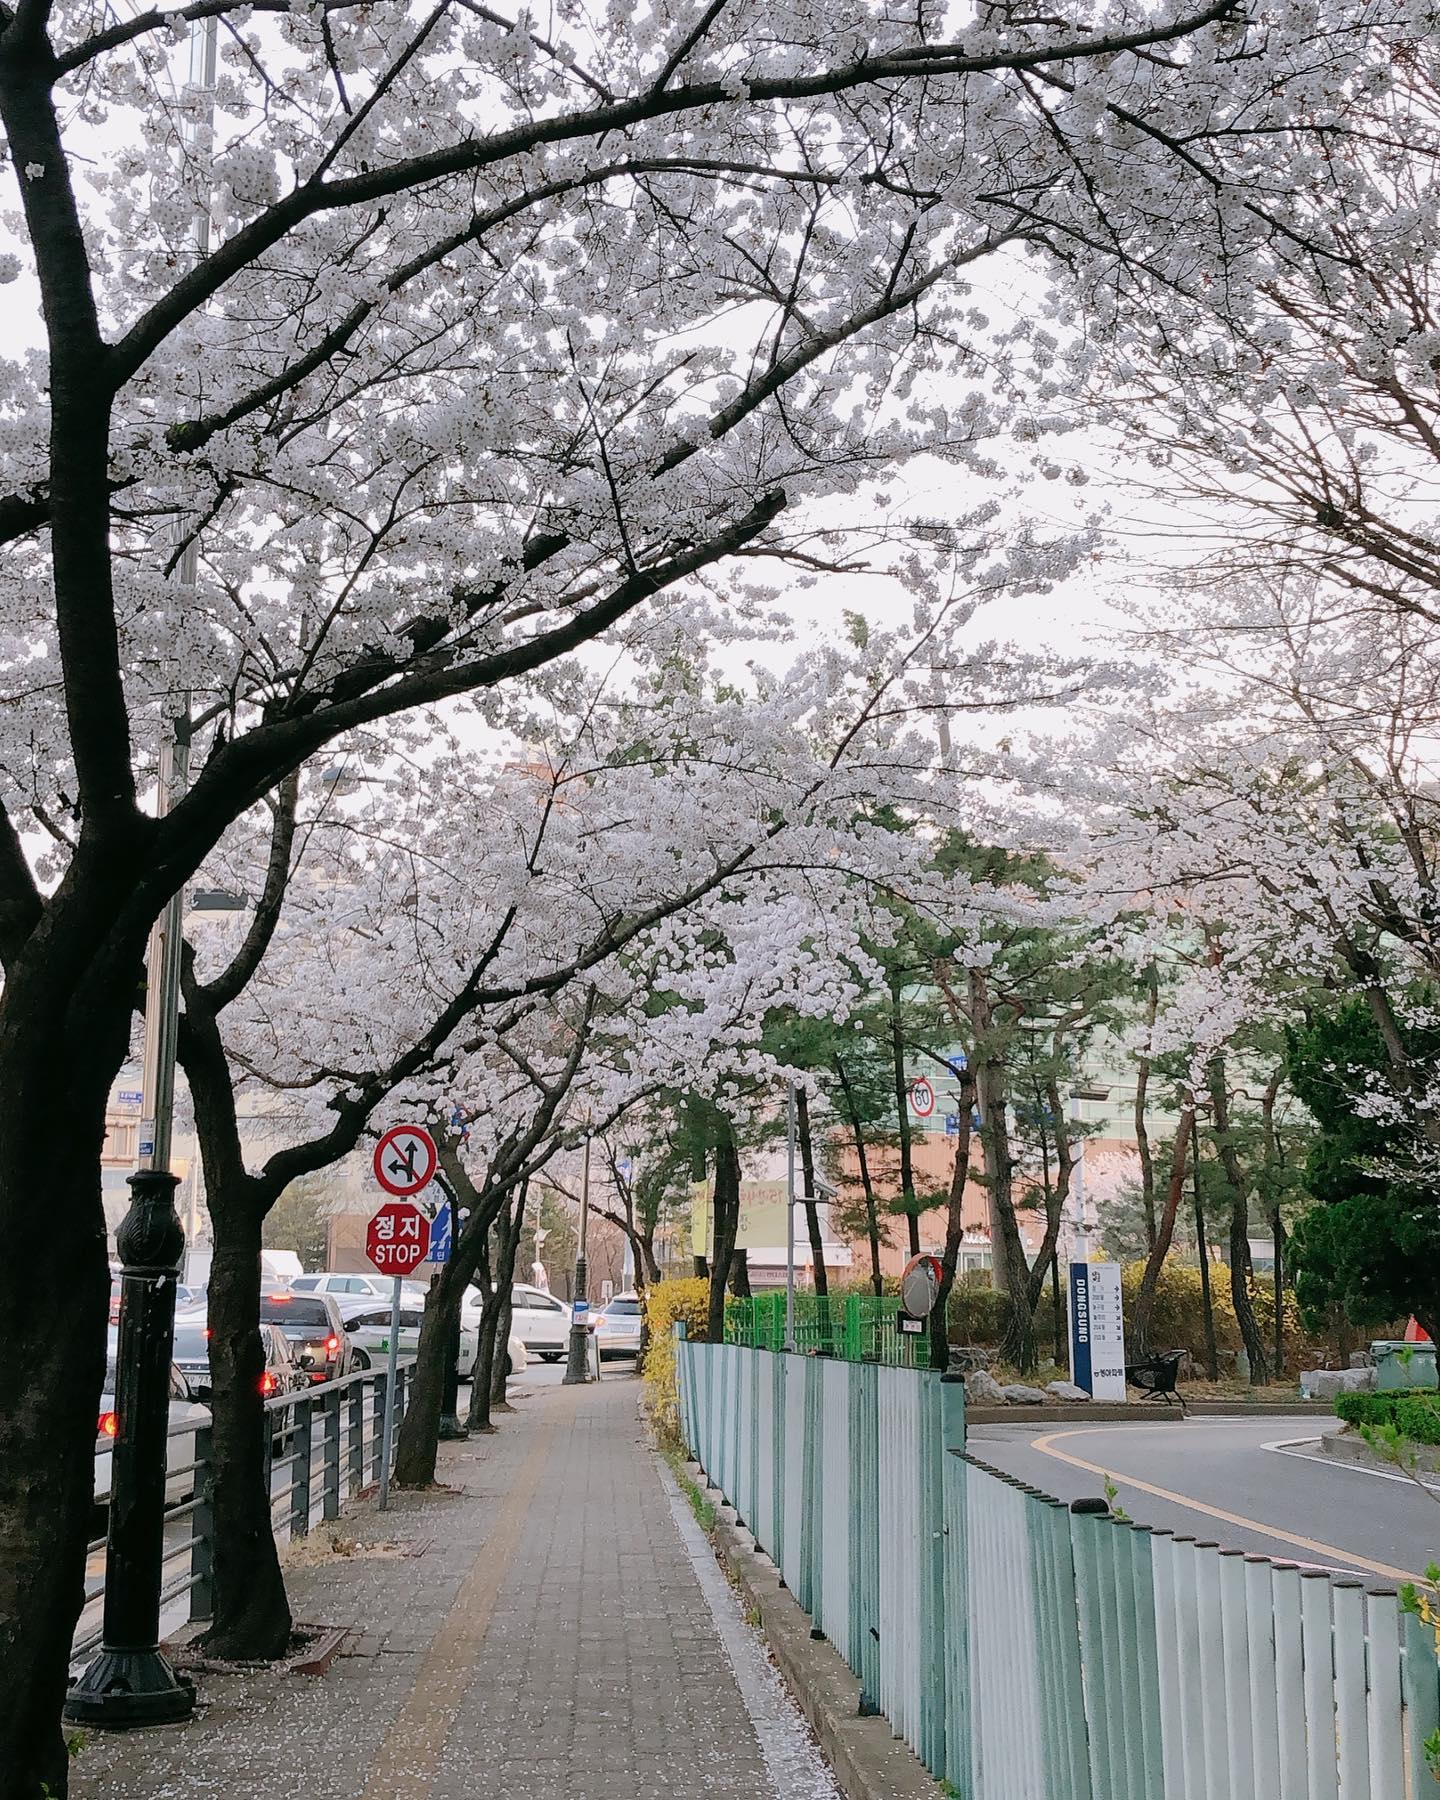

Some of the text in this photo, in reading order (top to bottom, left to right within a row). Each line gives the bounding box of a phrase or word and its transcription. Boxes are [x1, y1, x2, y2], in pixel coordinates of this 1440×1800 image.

[914, 1089, 929, 1107] 60
[375, 1215, 419, 1240] 정지
[375, 1244, 420, 1264] STOP
[1076, 1278, 1089, 1343] DONGSUNG
